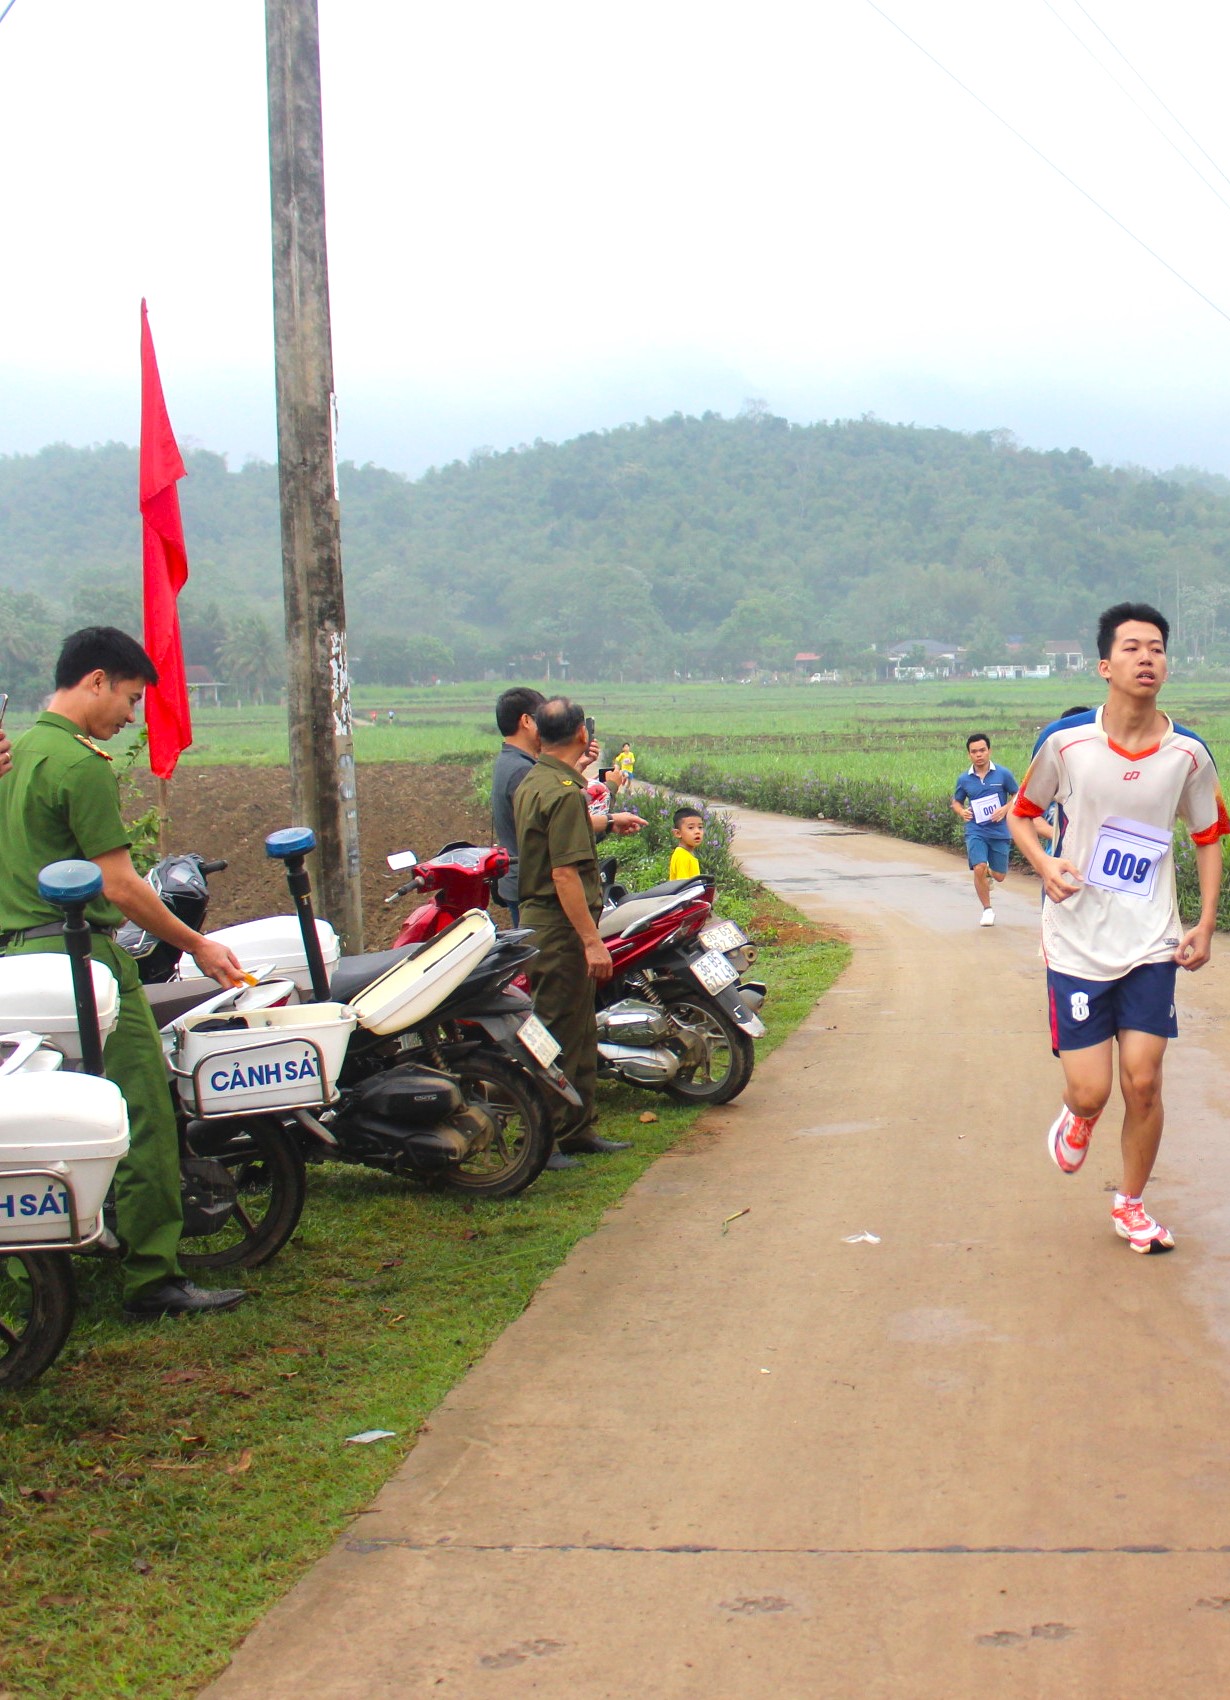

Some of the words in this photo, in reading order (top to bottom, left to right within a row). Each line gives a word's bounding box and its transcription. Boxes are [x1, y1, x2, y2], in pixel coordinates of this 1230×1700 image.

[1103, 848, 1151, 883] 009
[1070, 991, 1089, 1022] 8
[211, 1062, 281, 1092] CẢNH
[20, 1185, 69, 1216] SÁT
